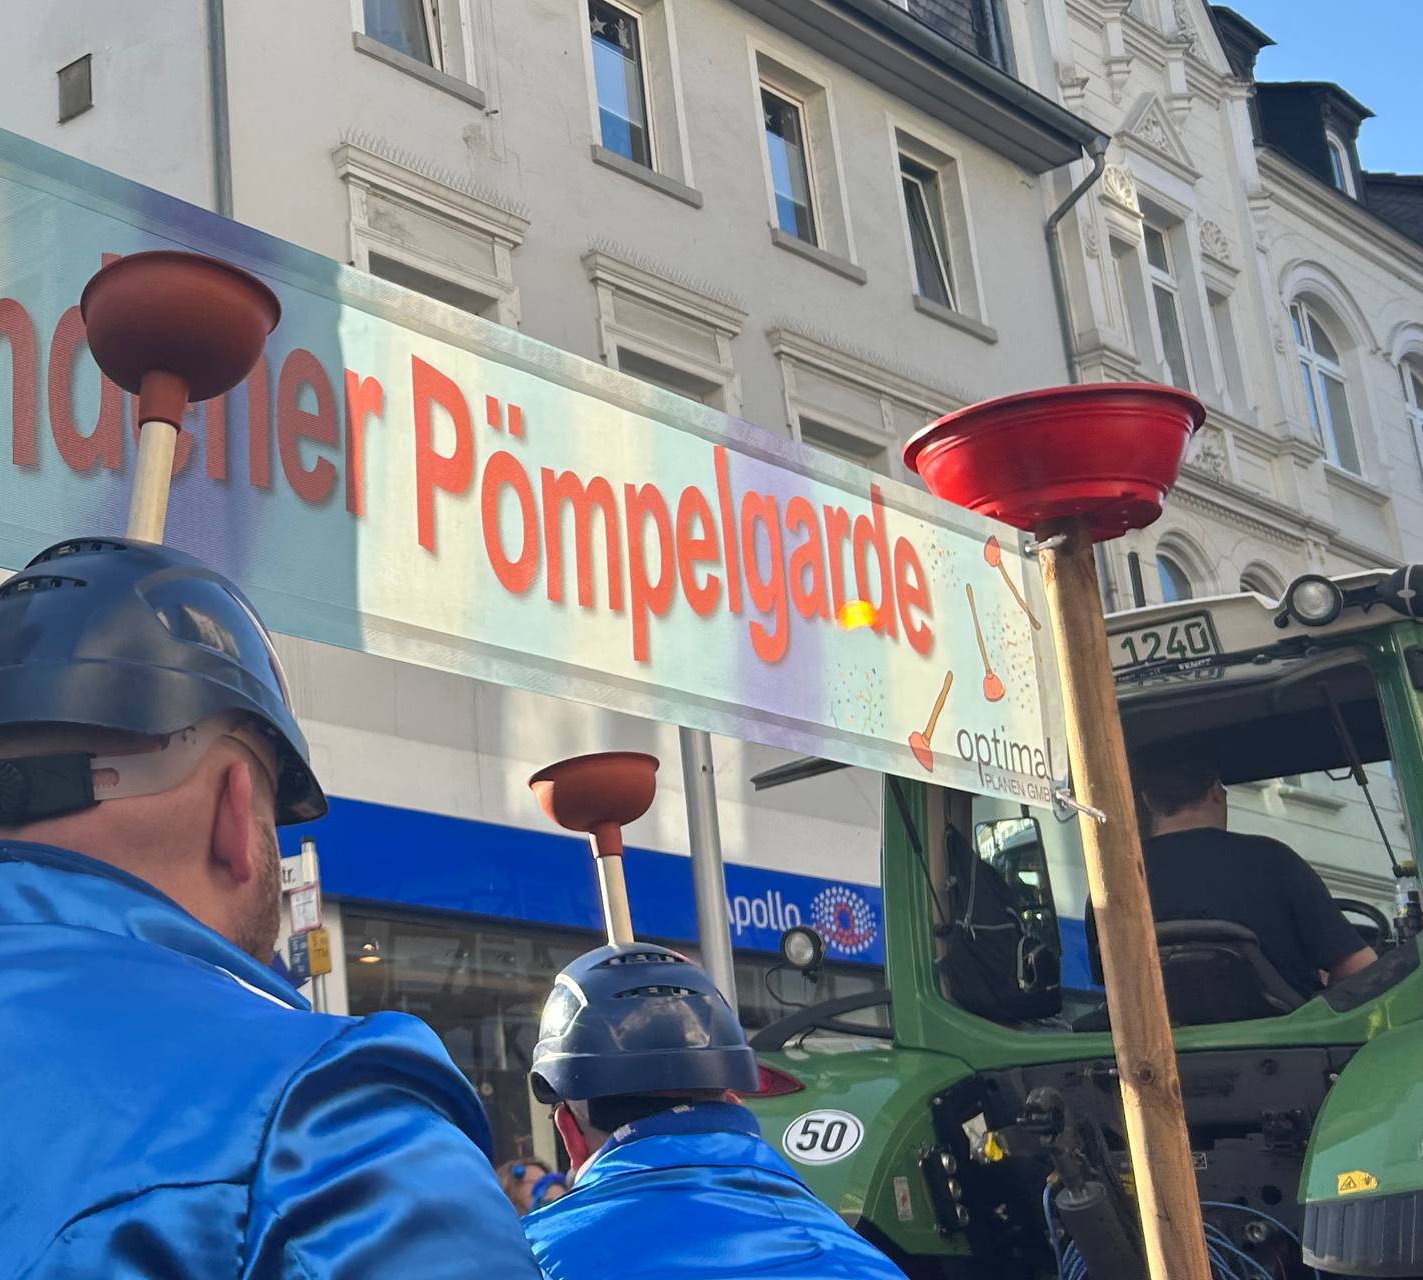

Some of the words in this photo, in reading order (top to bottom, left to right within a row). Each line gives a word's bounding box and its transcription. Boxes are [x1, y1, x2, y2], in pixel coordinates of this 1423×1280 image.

[411, 353, 934, 663] Pömpelgarde
[1120, 621, 1211, 665] 1240
[956, 724, 1055, 788] optimal
[984, 772, 1026, 796] PLANEN
[1026, 782, 1055, 803] GMB
[796, 1118, 848, 1153] 50
